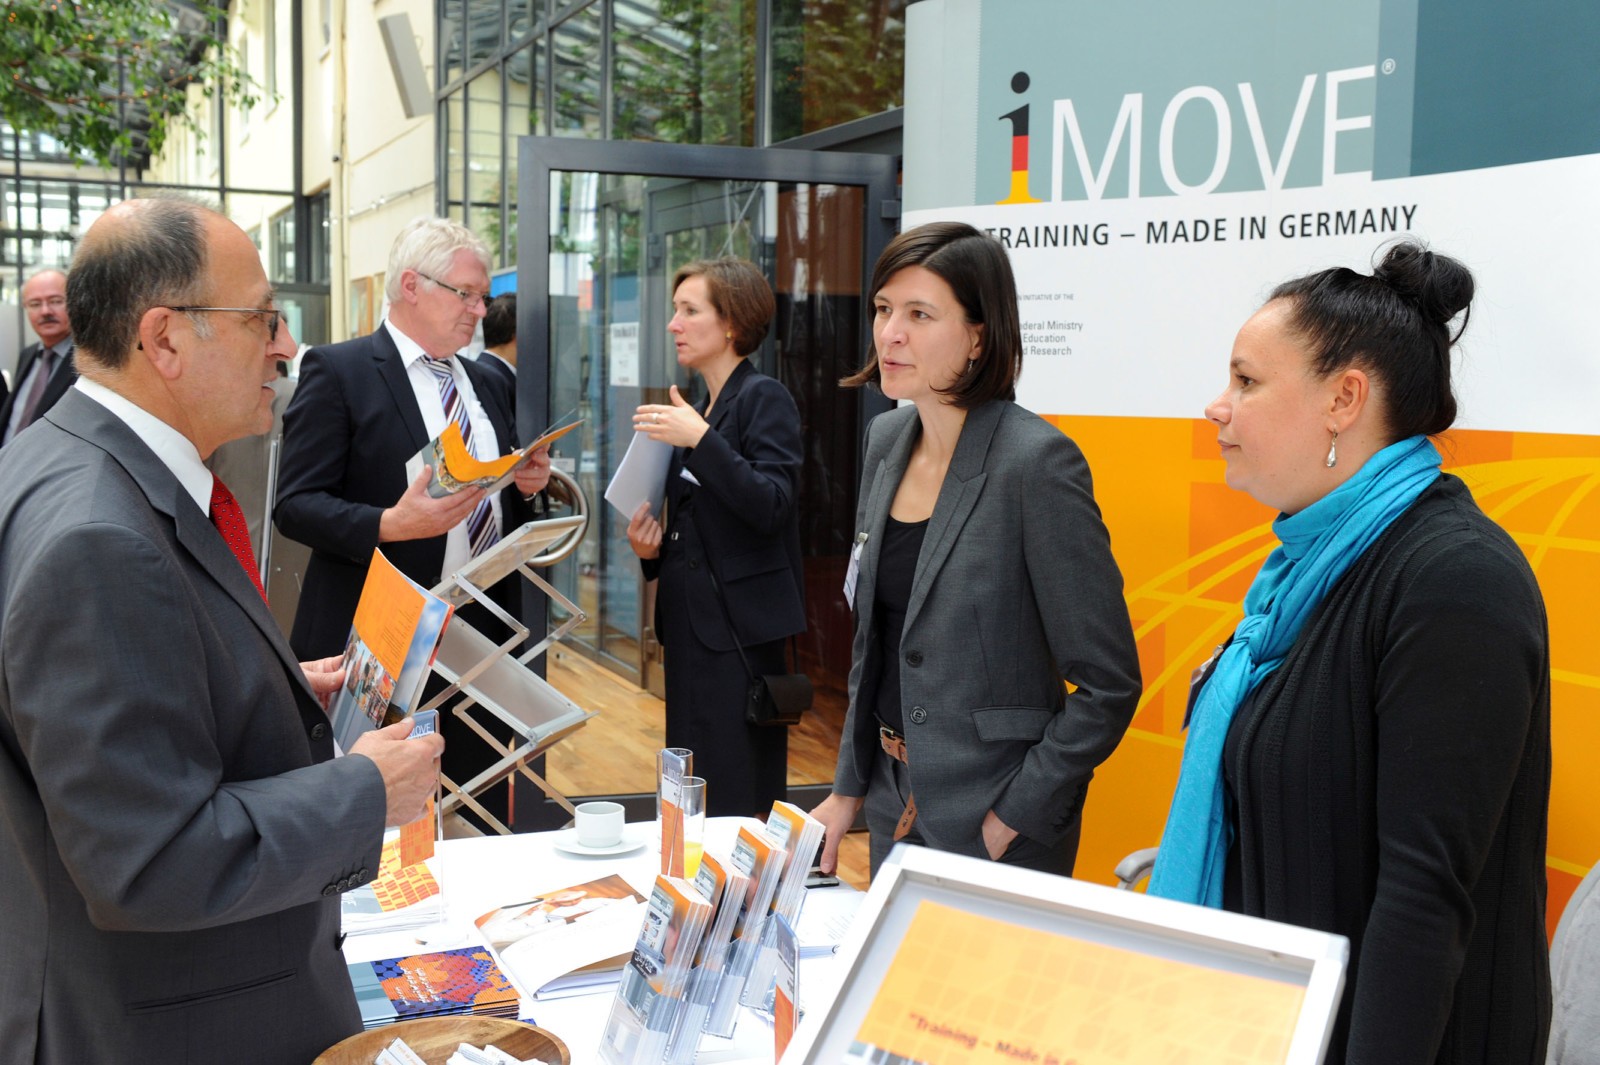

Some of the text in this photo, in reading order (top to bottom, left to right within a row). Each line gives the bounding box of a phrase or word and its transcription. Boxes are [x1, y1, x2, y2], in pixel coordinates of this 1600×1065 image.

[1146, 218, 1227, 245] MADE
[1240, 215, 1267, 241] IN
[1279, 204, 1418, 239] GERMANY
[1063, 292, 1074, 301] THE
[1020, 320, 1083, 332] deral Ministry
[1023, 333, 1066, 343] Education
[1030, 345, 1072, 356] Research
